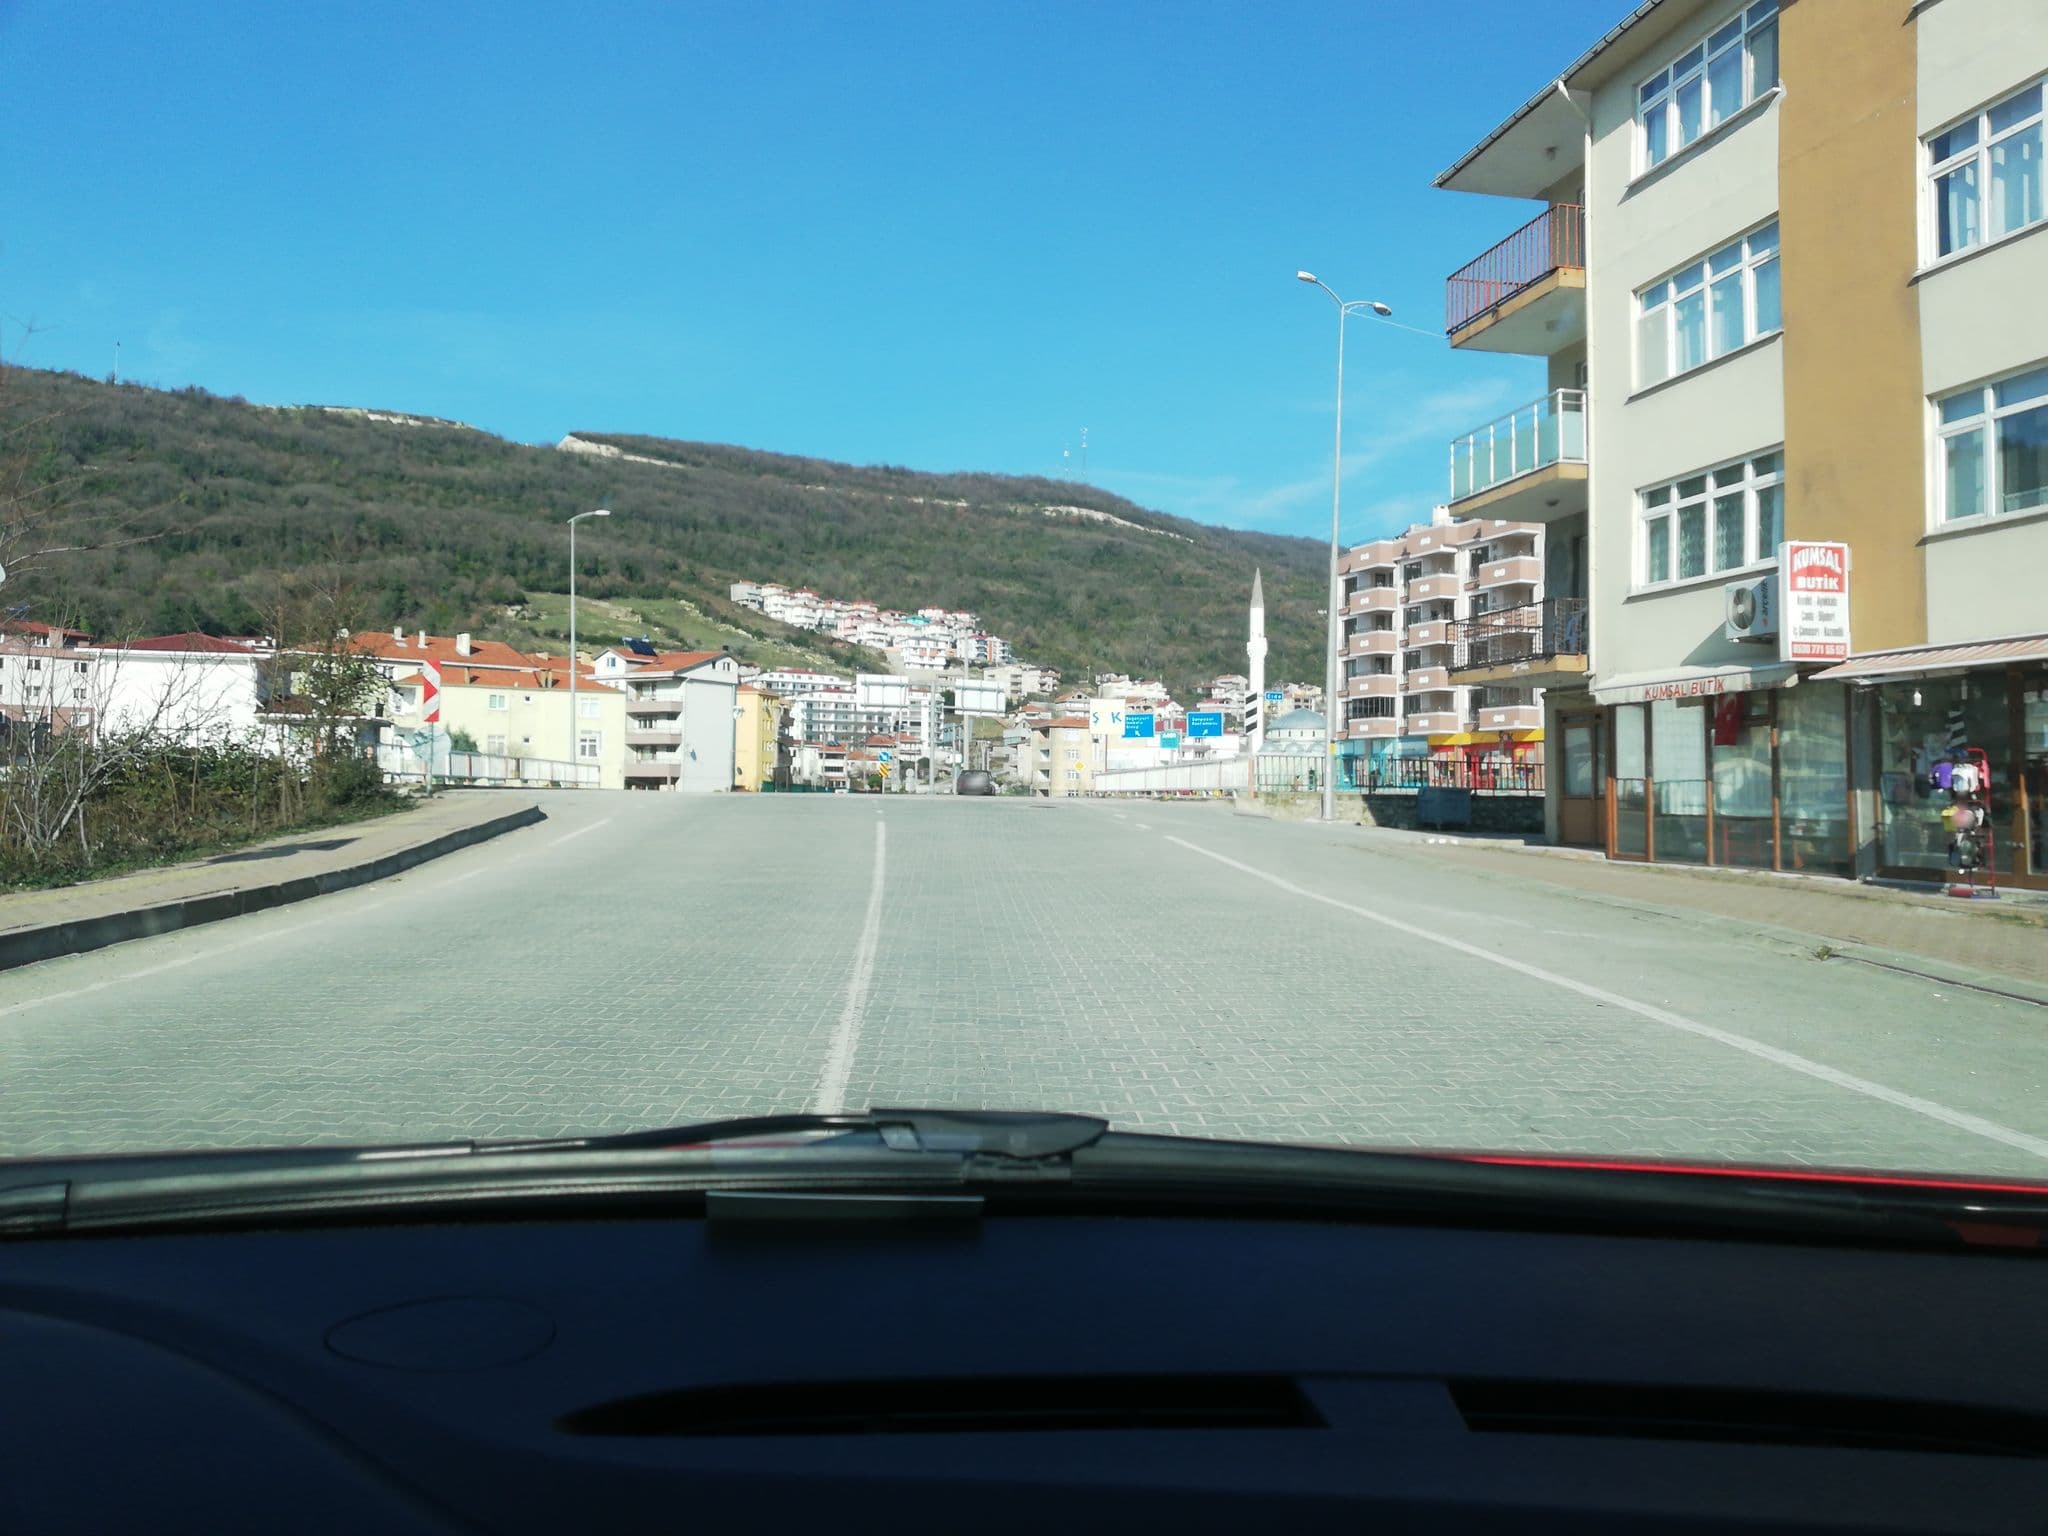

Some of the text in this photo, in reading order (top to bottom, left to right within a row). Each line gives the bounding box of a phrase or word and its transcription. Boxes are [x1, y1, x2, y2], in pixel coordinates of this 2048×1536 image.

[1792, 547, 1842, 574] KUMSAL
[1797, 574, 1840, 590] BUTİK
[1644, 683, 1687, 699] KUMSAL
[1690, 676, 1725, 695] BUTİK
